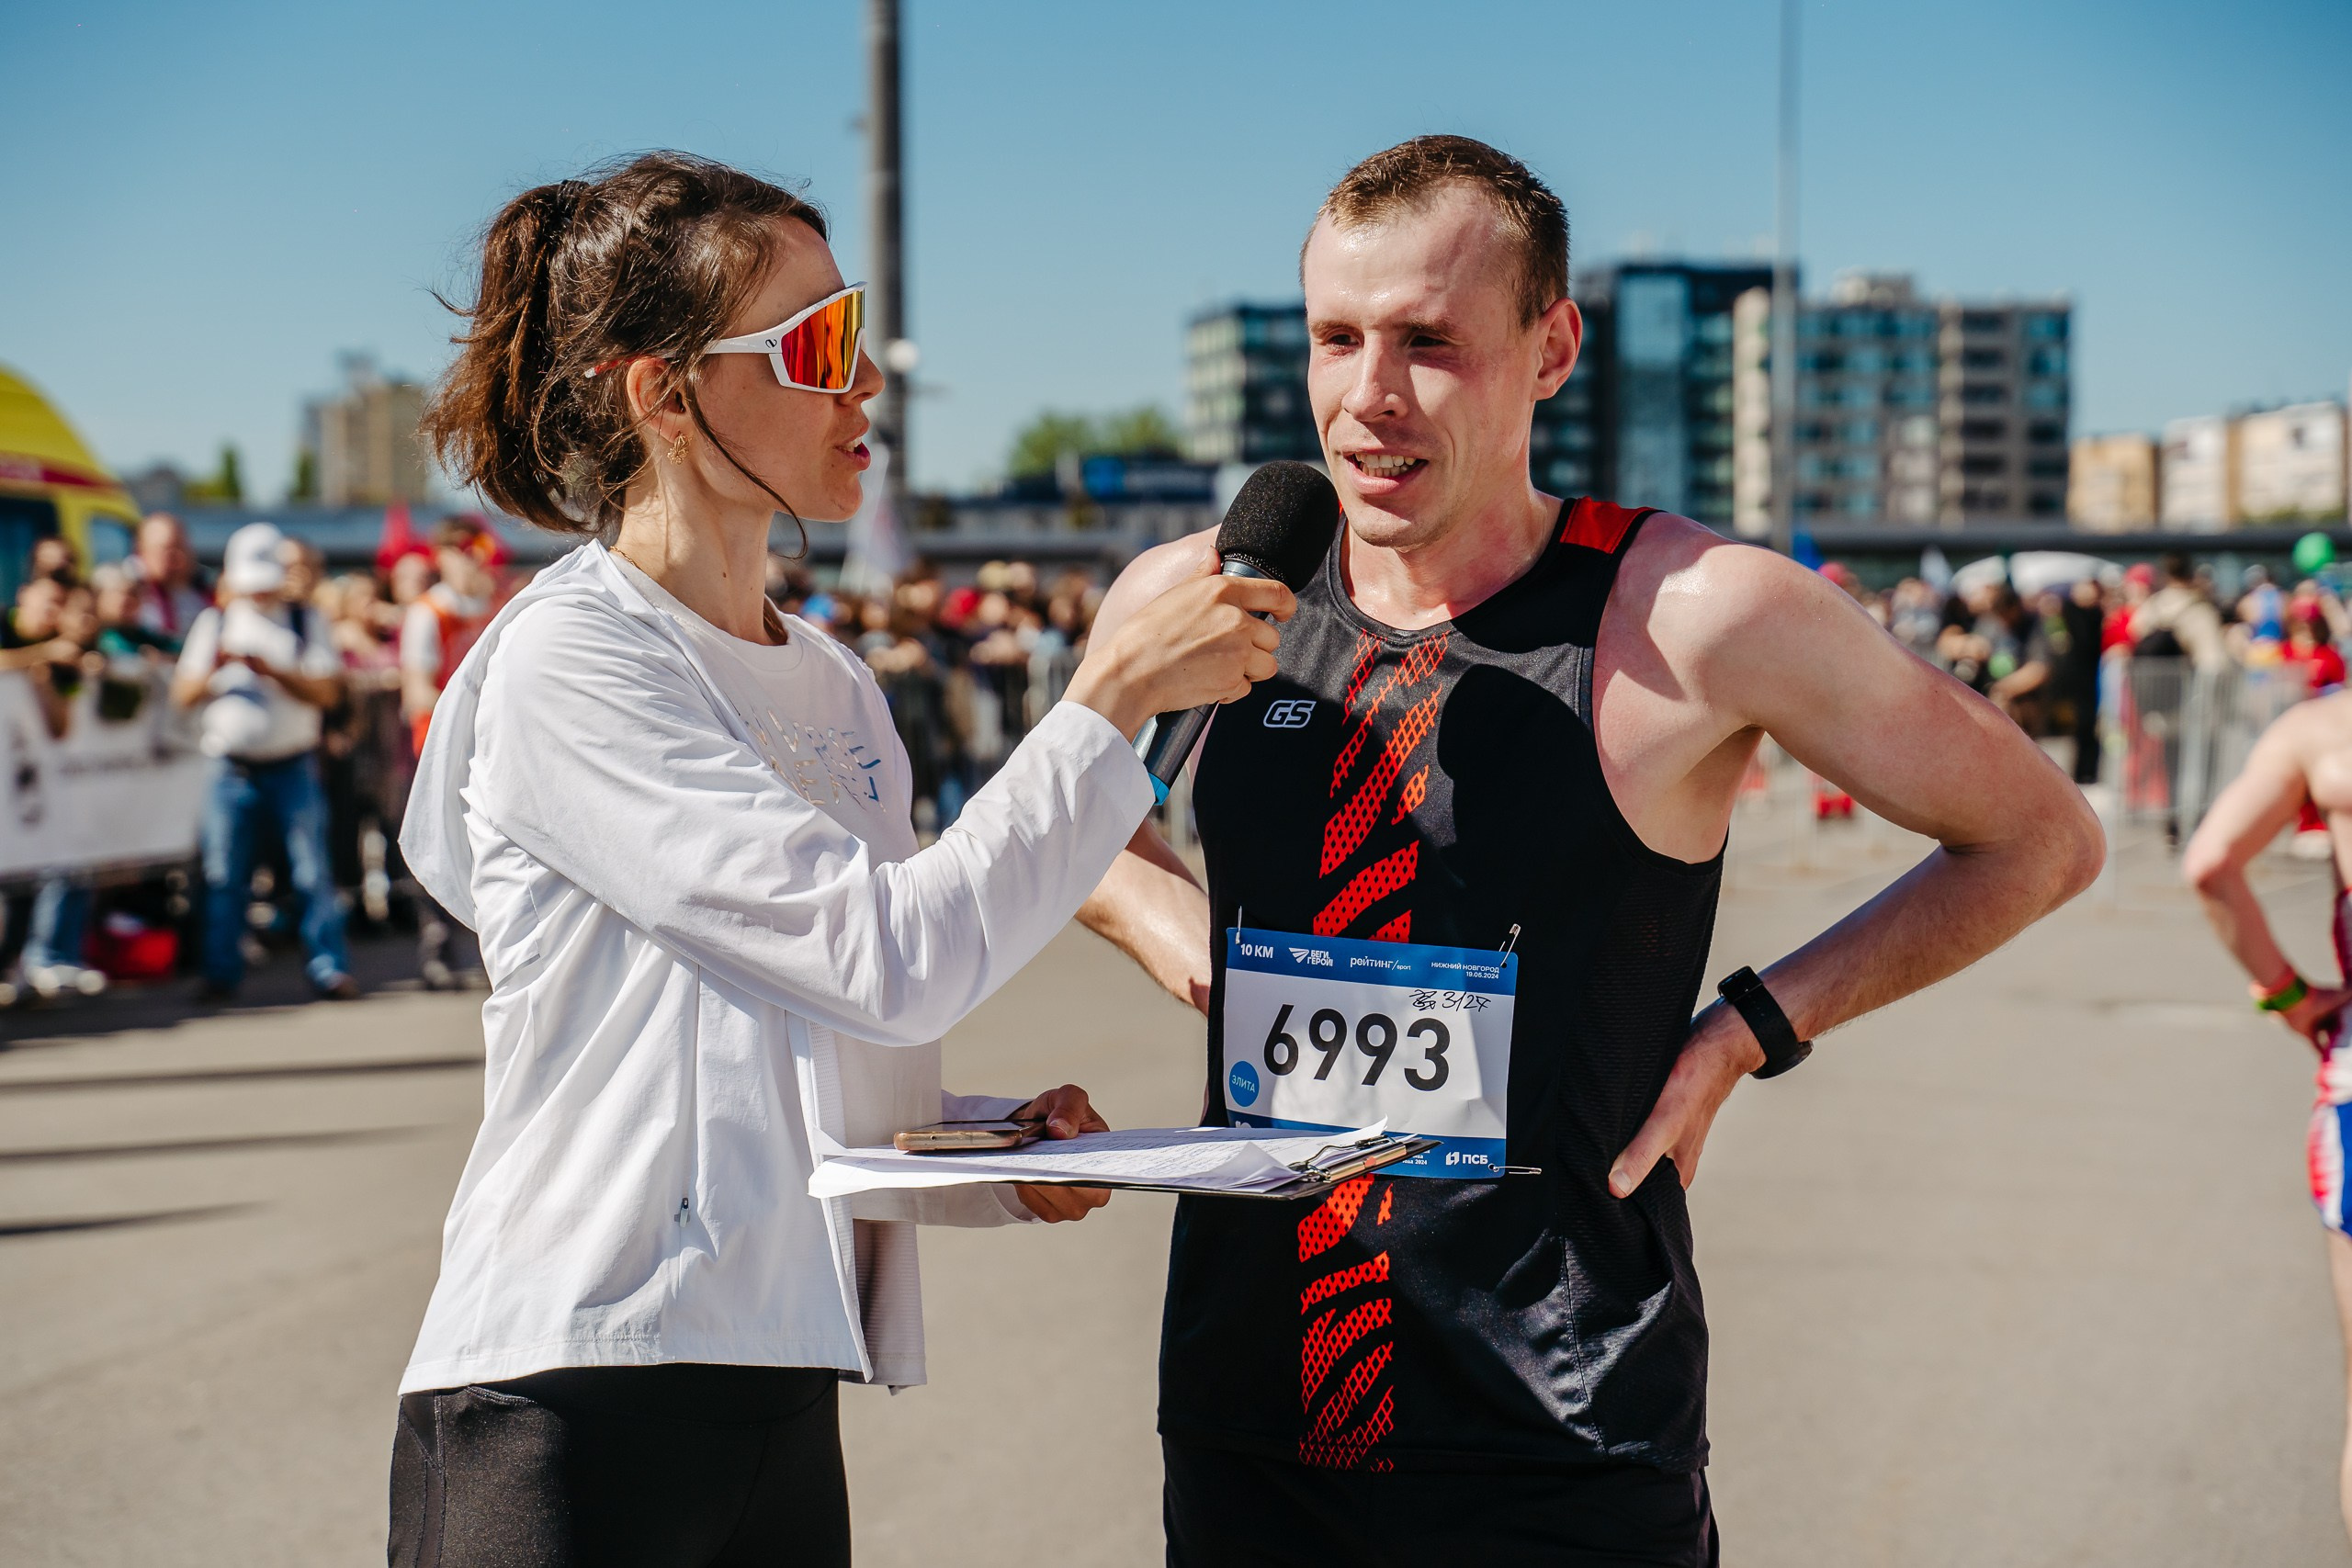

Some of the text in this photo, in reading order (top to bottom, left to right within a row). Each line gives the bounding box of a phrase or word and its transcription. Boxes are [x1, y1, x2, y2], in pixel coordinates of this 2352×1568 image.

[1263, 700, 1317, 728] GS
[1240, 943, 1252, 955] 10
[1430, 962, 1499, 973] НИЖНИЙ НОВГОРОД
[1263, 1003, 1451, 1091] 6993
[1231, 1075, 1255, 1092] ЭЛИТА
[1462, 1155, 1488, 1165] ПСБ
